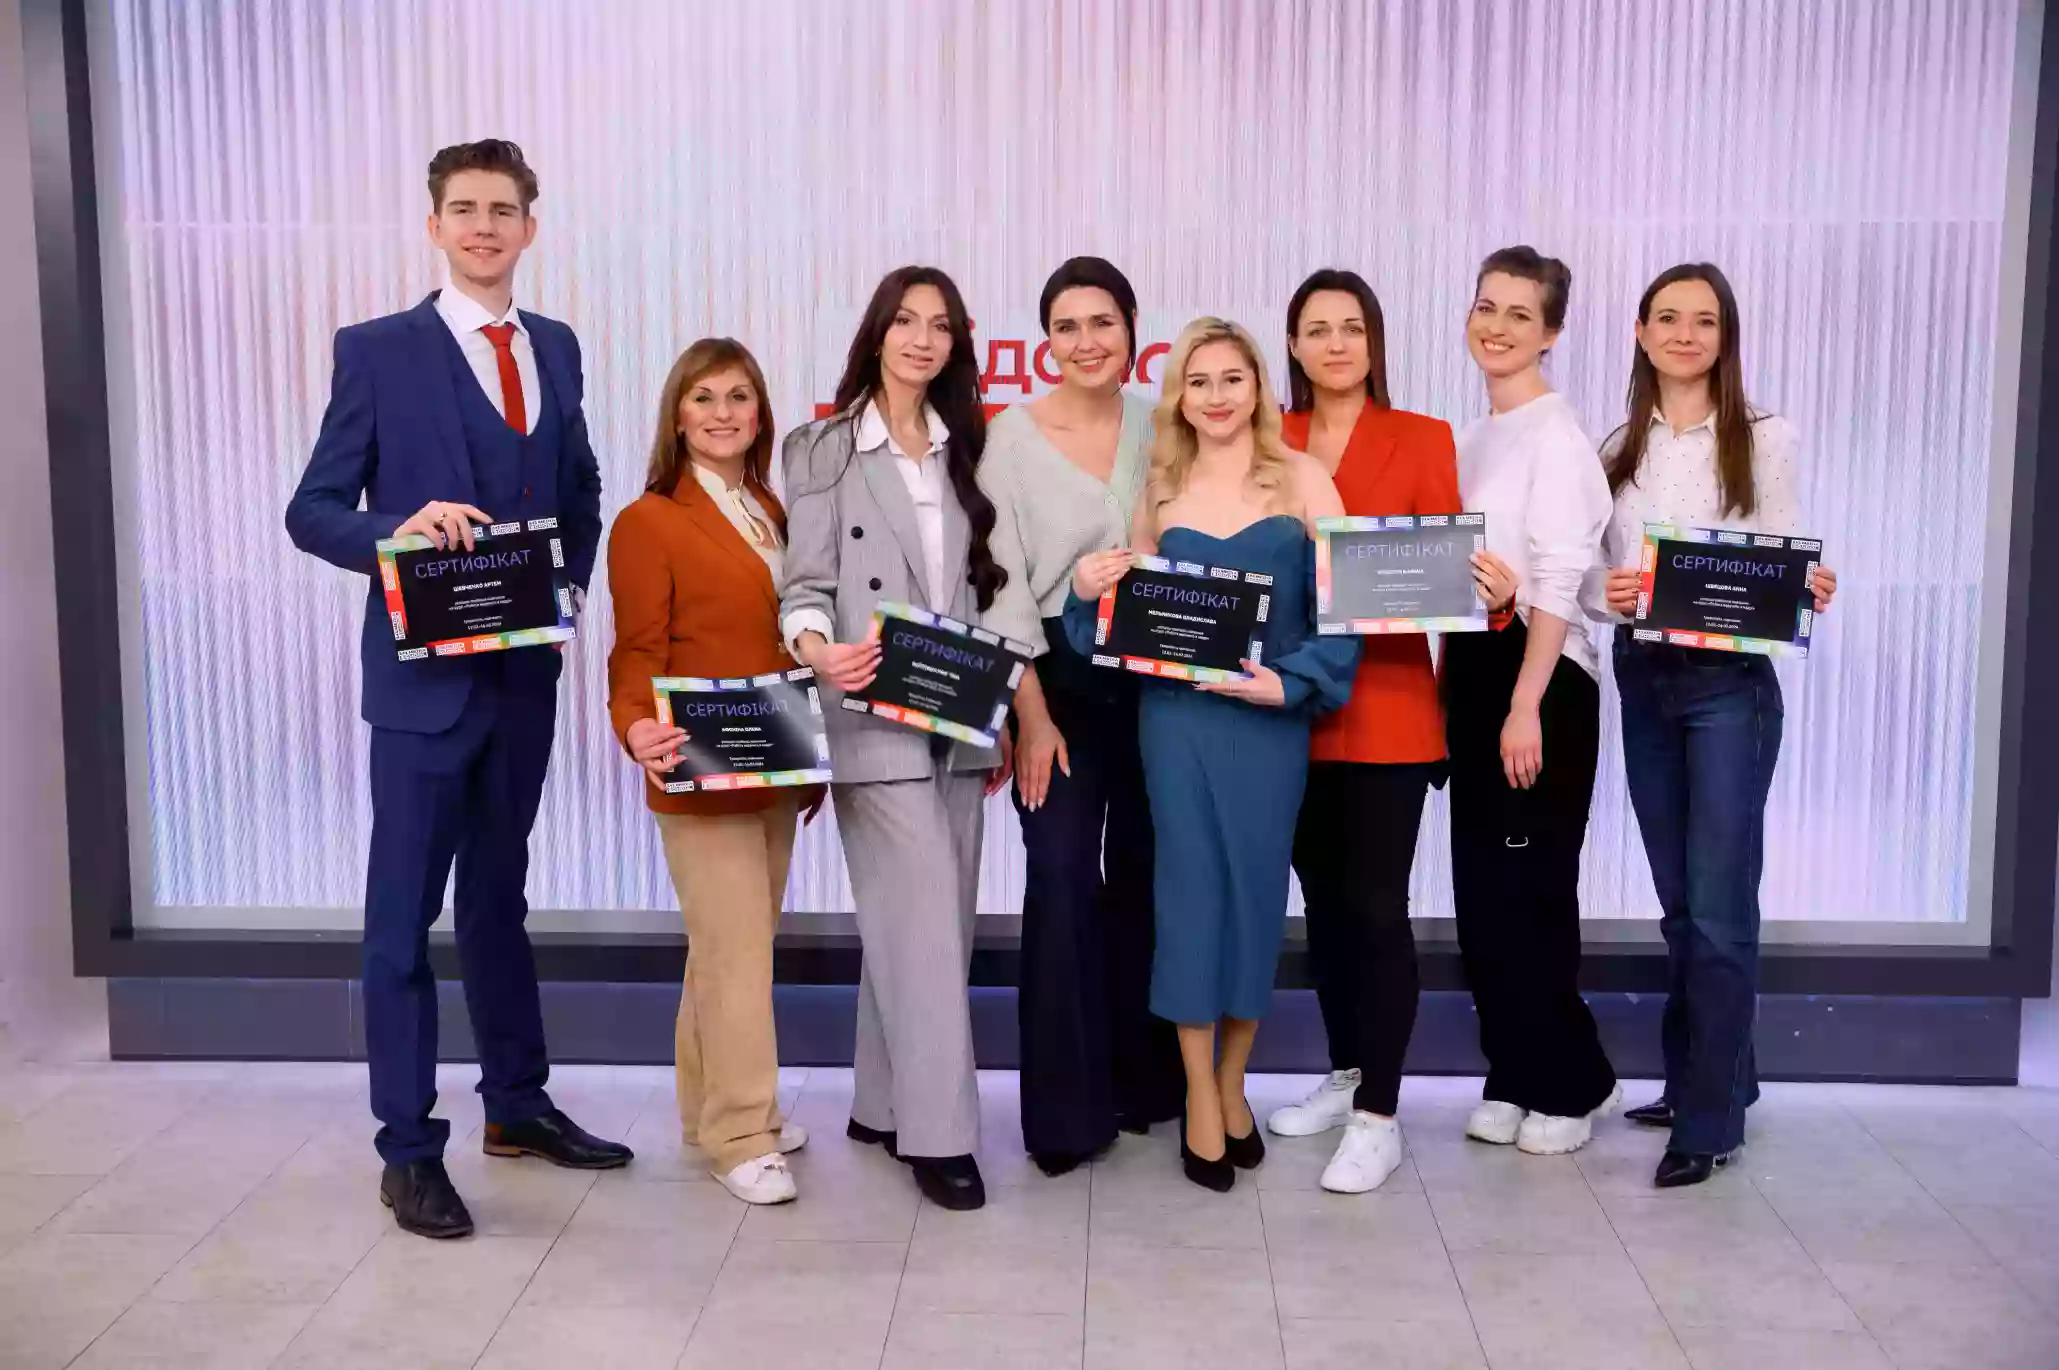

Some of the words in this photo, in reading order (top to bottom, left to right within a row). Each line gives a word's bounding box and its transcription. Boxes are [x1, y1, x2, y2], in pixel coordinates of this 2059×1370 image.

[1346, 541, 1455, 559] СЕРТИФІКАТ
[415, 549, 532, 579] СЕРТИФІКАТ
[1672, 554, 1787, 579] СЕРТИФІКАТ
[1132, 582, 1241, 611] СЕРТИФІКАТ
[892, 631, 996, 673] СЕРТИФІКАТ
[686, 699, 789, 717] СЕРТИФІКАТ
